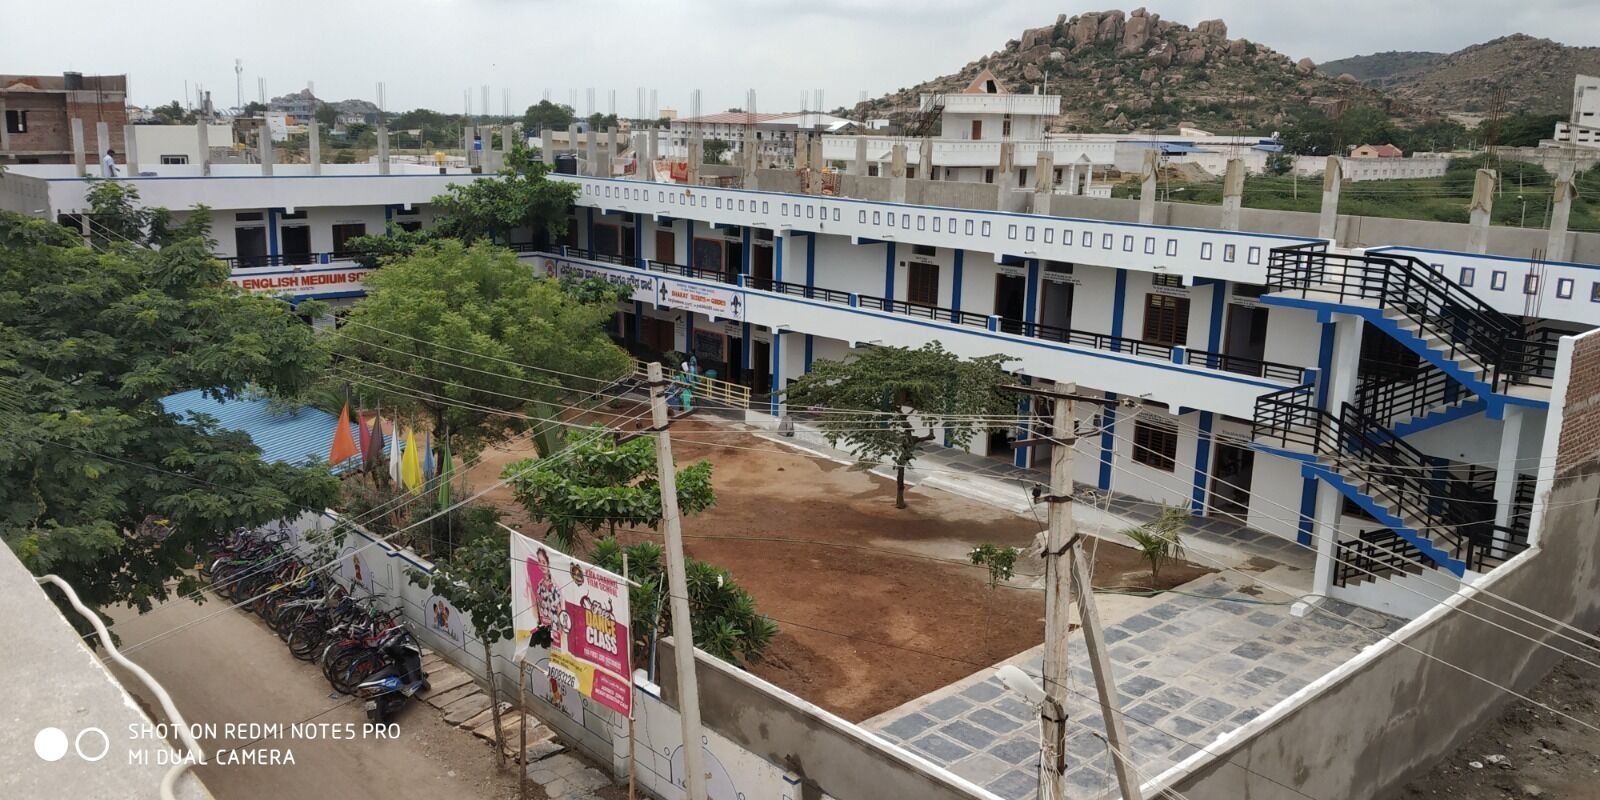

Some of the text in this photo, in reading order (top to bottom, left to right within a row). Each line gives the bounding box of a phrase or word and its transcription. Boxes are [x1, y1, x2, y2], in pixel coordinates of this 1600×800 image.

[243, 276, 299, 290] ENGLISH
[301, 273, 346, 286] MEDIUM
[585, 609, 616, 638] DANCE
[586, 627, 618, 655] CLASS
